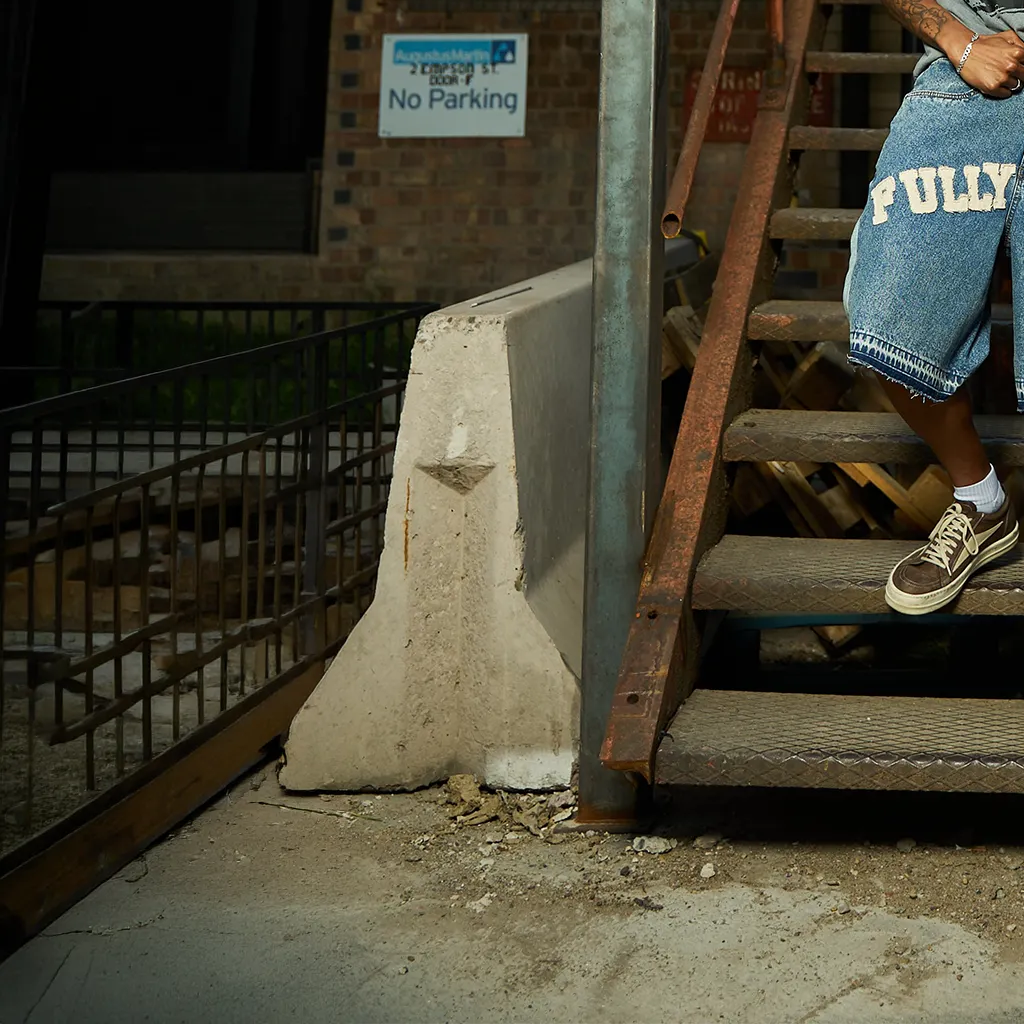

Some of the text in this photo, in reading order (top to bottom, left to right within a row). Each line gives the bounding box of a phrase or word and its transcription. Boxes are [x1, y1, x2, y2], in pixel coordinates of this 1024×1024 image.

[389, 88, 518, 114] No Parking
[871, 162, 1017, 226] FULLY
